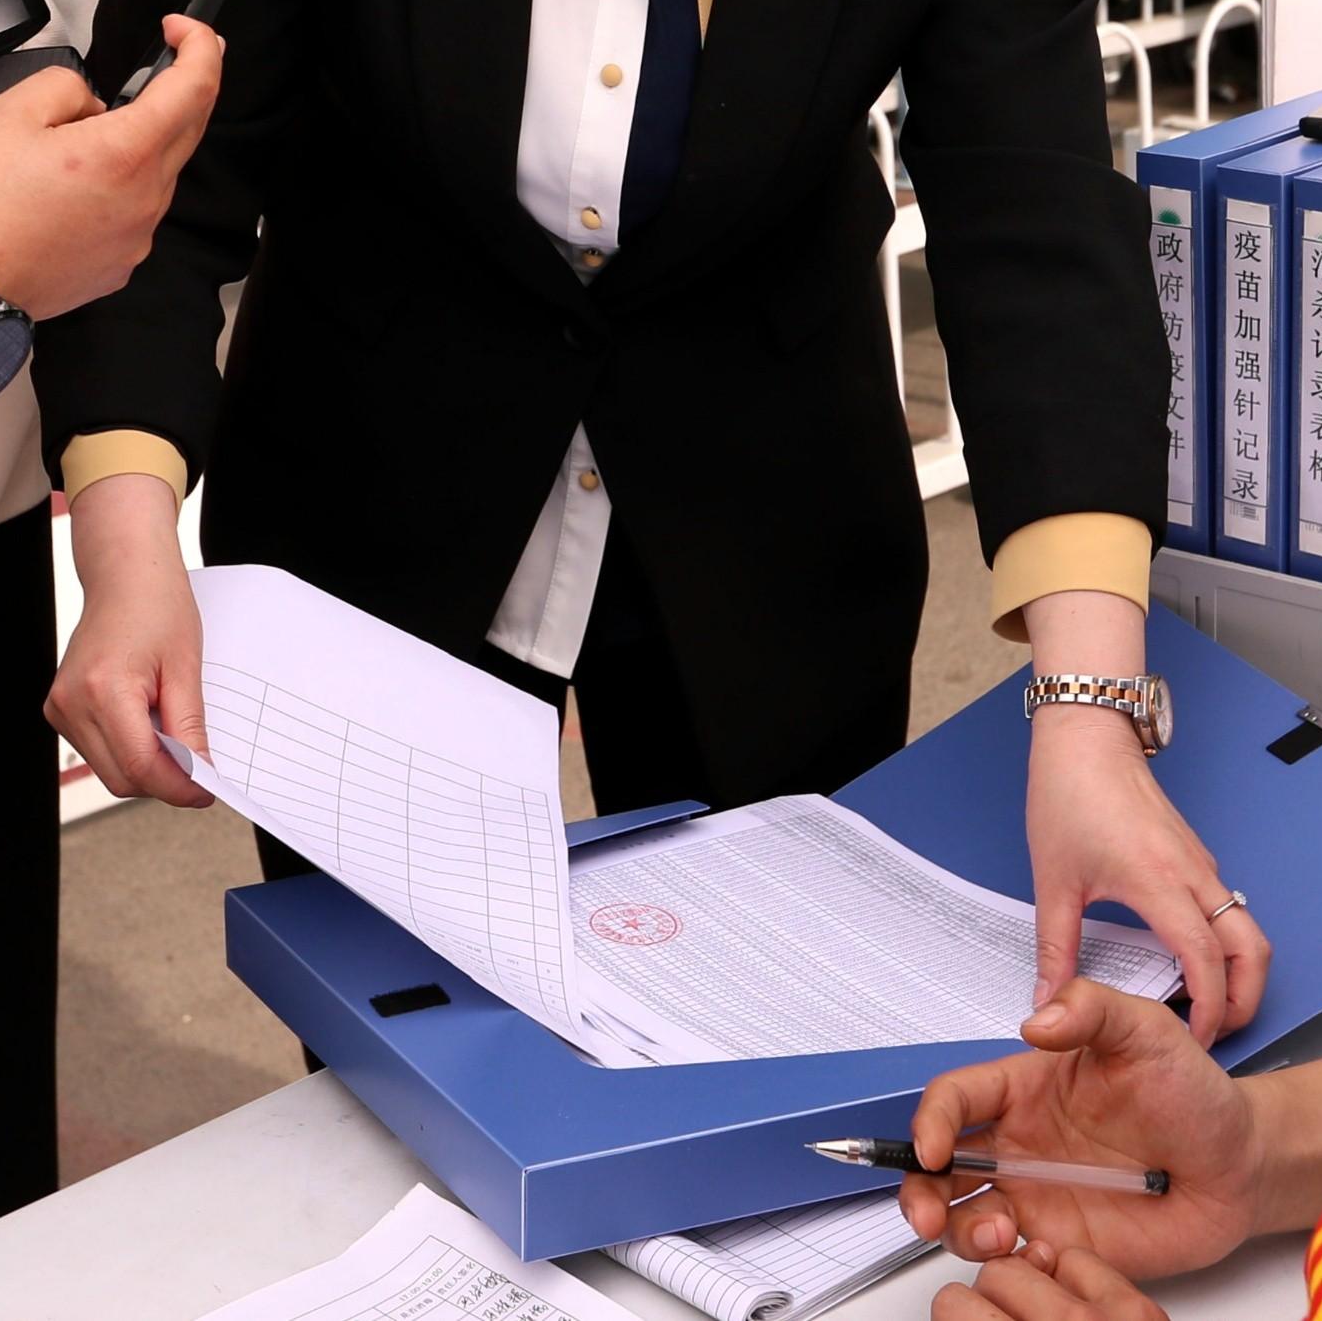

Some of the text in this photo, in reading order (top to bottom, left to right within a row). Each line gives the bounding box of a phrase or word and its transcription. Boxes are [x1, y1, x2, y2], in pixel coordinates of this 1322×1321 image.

[1231, 230, 1263, 500] 疫苗加强针记录
